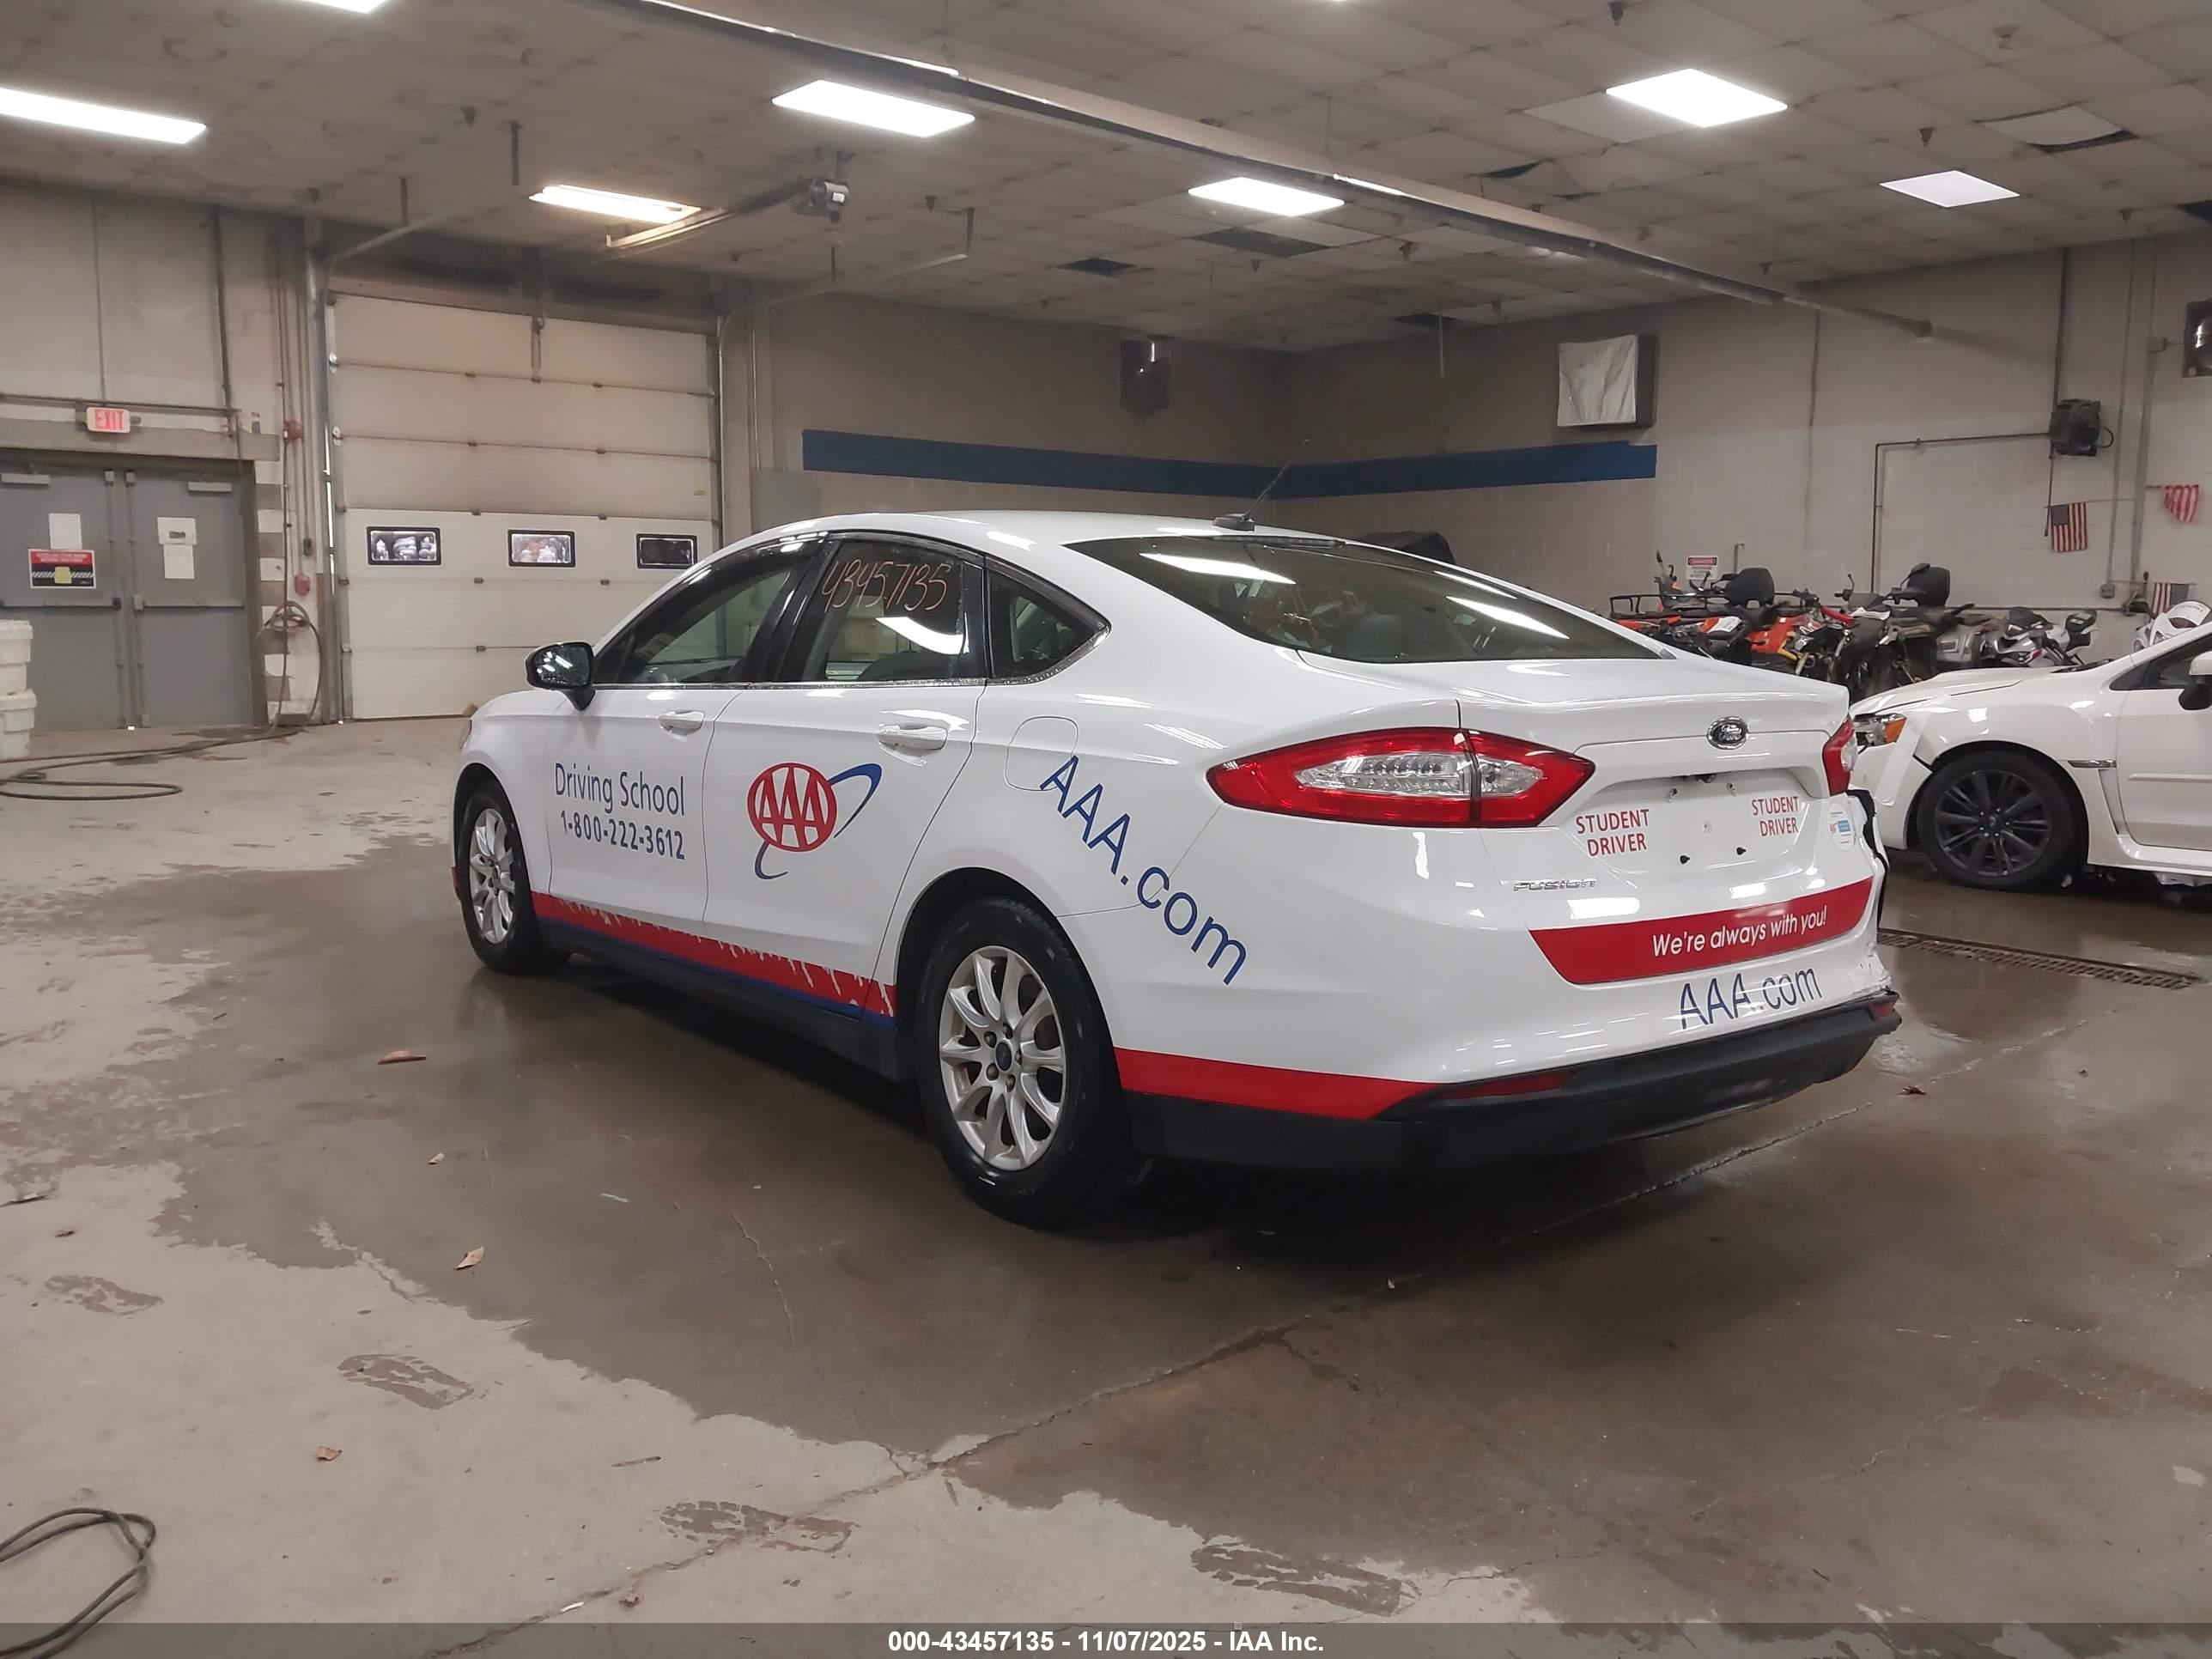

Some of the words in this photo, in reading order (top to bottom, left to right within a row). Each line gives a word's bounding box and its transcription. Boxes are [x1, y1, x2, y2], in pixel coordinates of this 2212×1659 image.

[95, 409, 124, 430] EXIT
[822, 560, 951, 613] 43457135
[555, 763, 612, 814] Driving
[620, 771, 684, 817] School
[749, 763, 836, 851] AAA
[1751, 796, 1799, 816] STUDENT
[561, 810, 684, 860] 1-800-222-3612
[1576, 809, 1650, 834] STUDENT
[1587, 833, 1647, 857] DRIVER
[1759, 817, 1799, 836] DRIVER
[1039, 755, 1247, 985] AAA.com
[1652, 930, 1705, 957] We're
[1710, 923, 1766, 946] always
[1771, 914, 1798, 937] with
[1802, 905, 1827, 935] you!
[1680, 968, 1823, 1030] AAA.com
